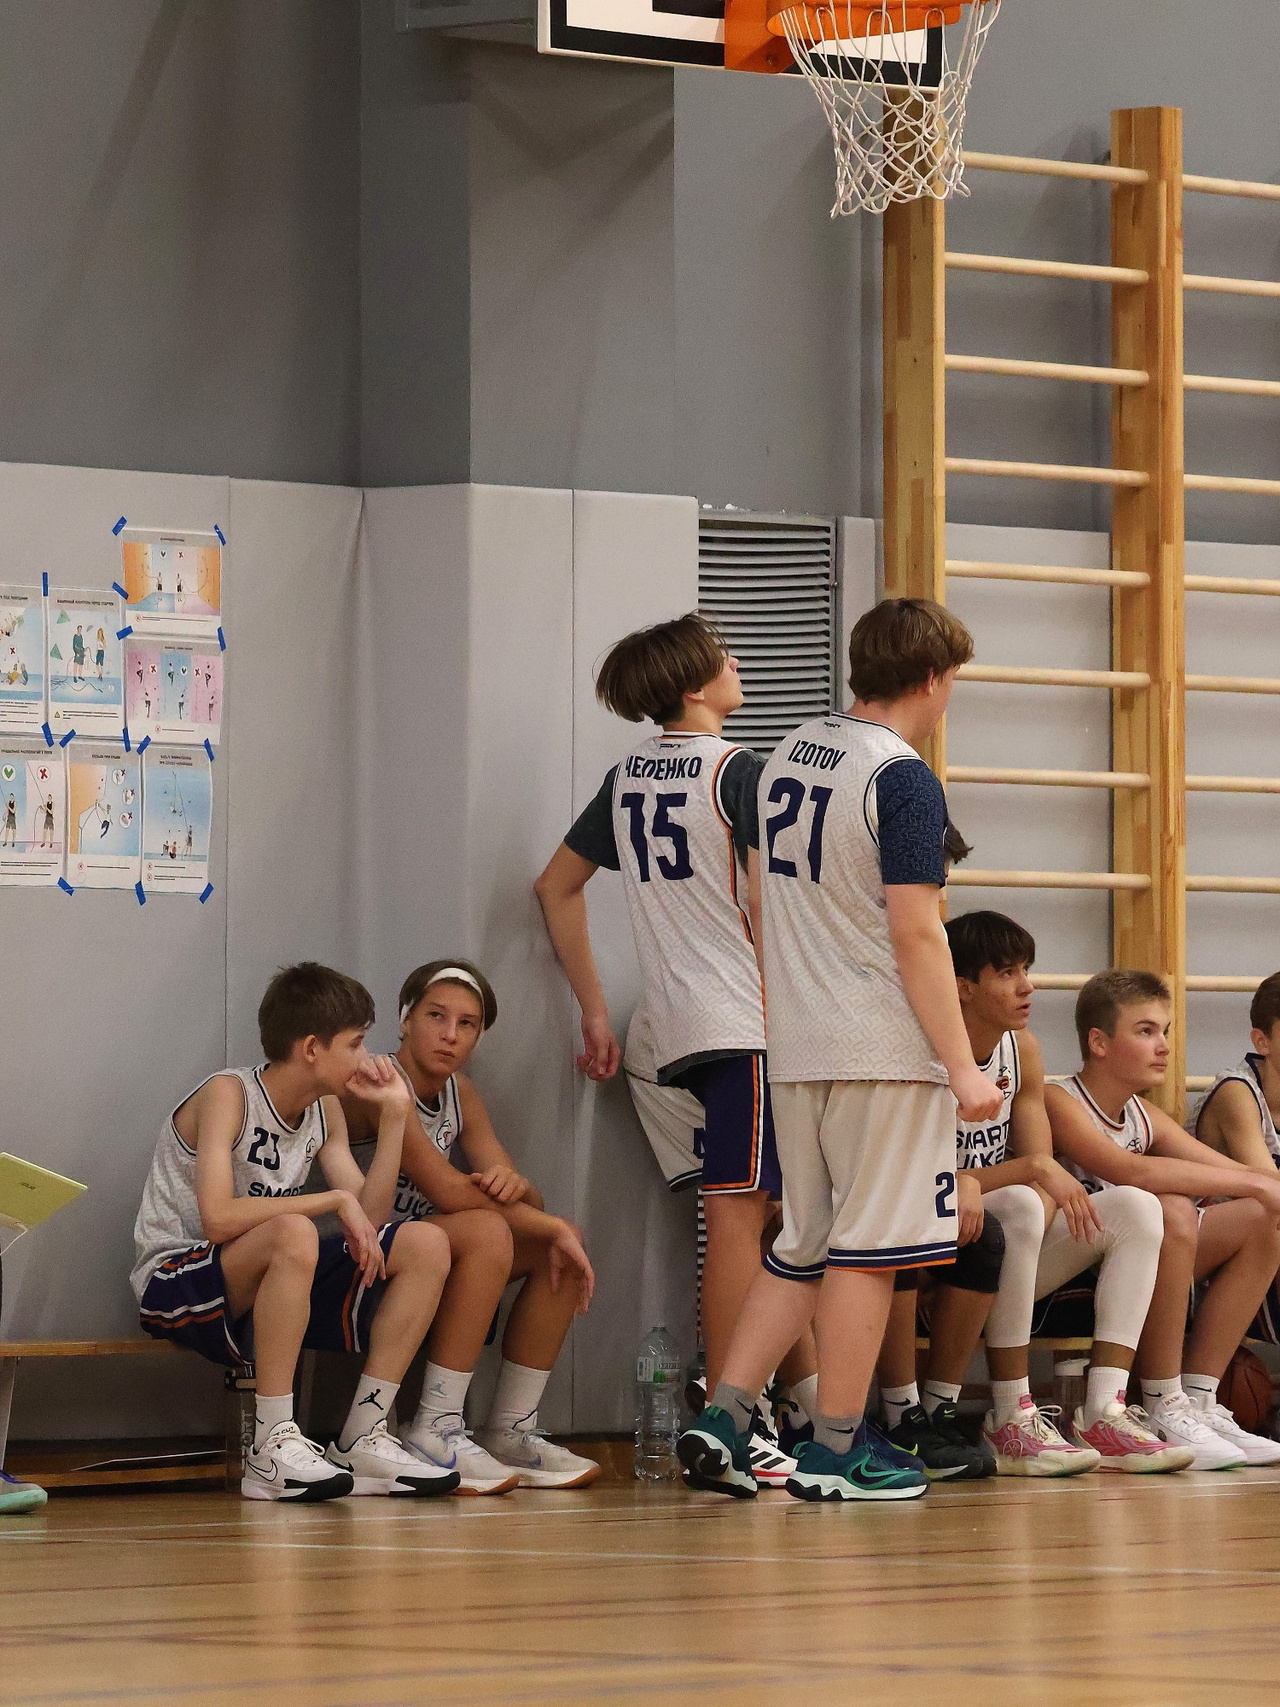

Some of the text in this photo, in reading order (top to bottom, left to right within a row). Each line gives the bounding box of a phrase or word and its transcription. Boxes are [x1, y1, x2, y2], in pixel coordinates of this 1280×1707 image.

[788, 740, 847, 771] IZOTOV
[620, 792, 695, 883] 15
[766, 777, 834, 884] 21
